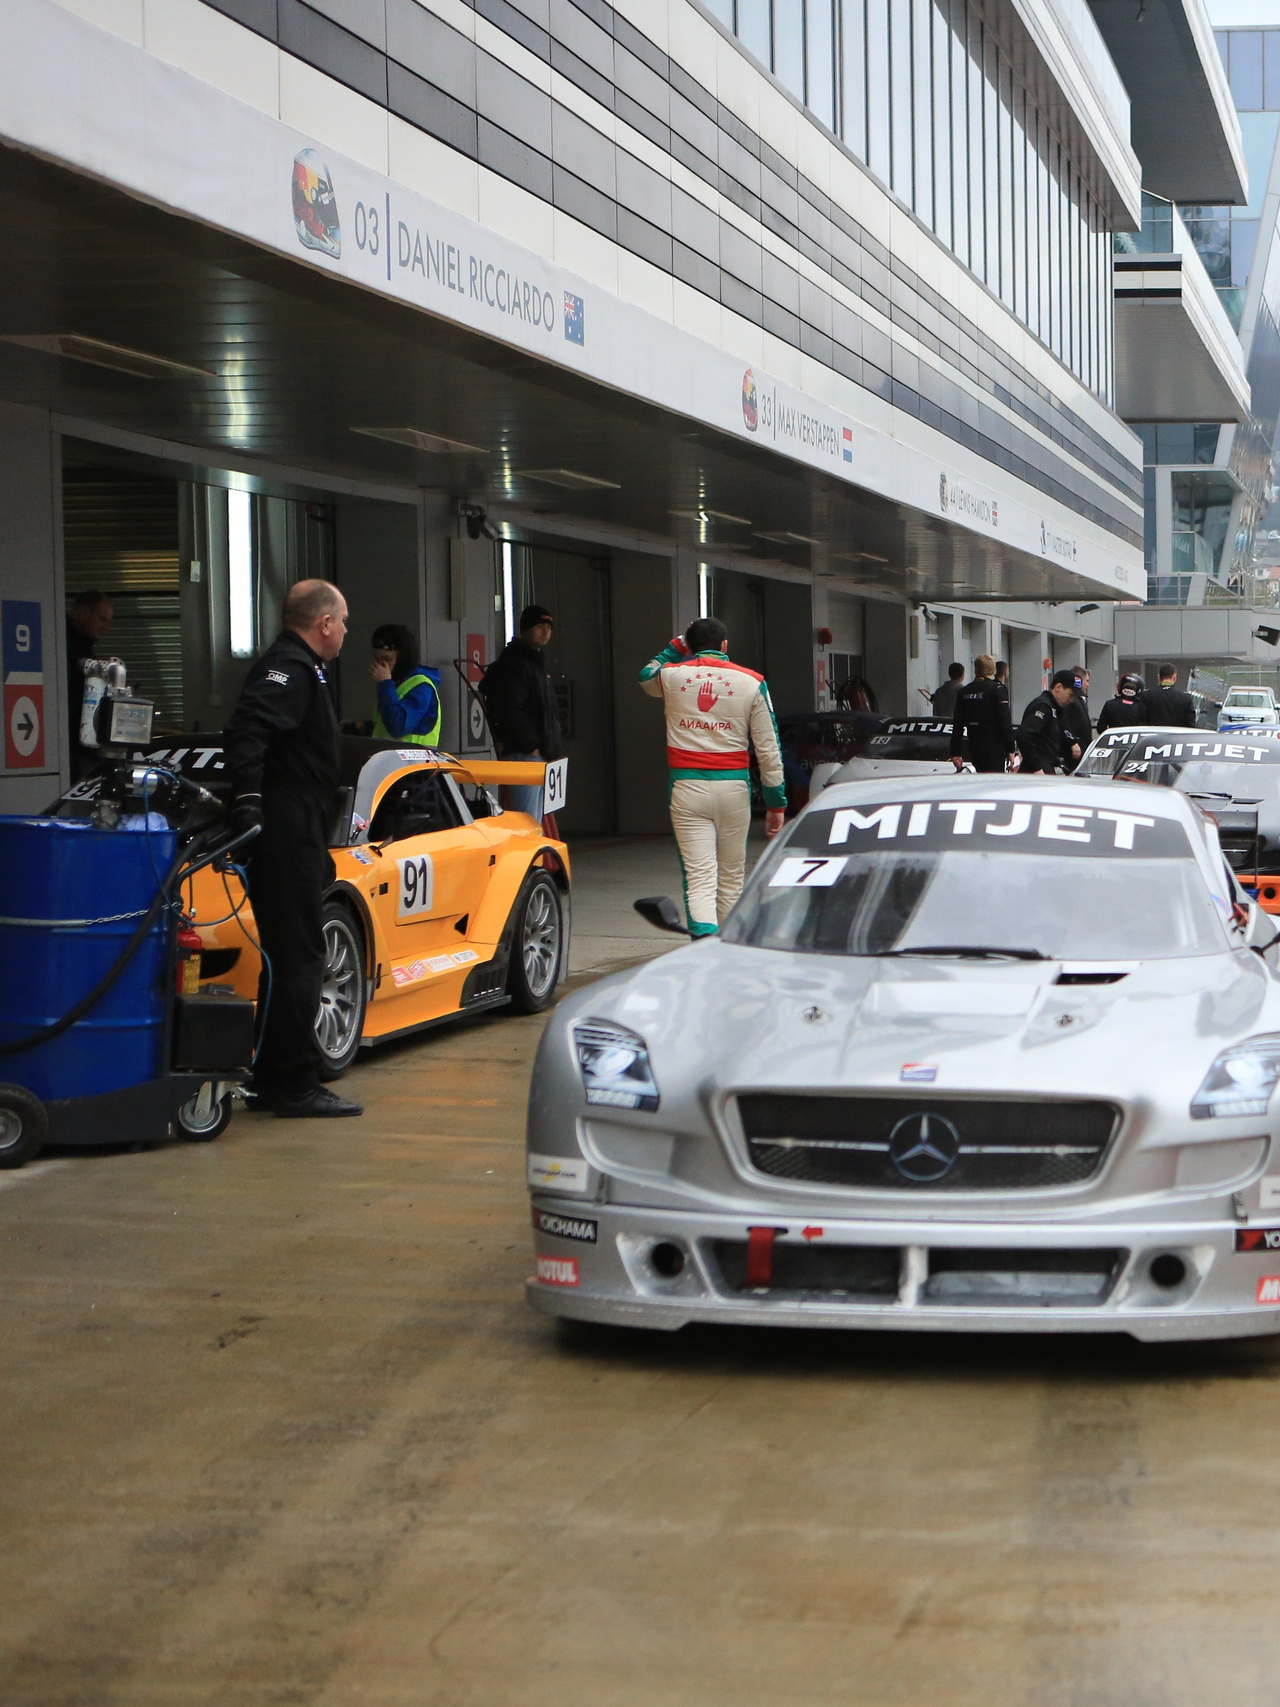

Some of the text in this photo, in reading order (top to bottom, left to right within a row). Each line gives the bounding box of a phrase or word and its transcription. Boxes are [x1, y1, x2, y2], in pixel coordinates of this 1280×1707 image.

[354, 201, 379, 256] 03
[397, 220, 464, 295] DANIEL
[469, 255, 555, 333] RICCIARDO
[761, 394, 840, 456] 33 MAX VERSTAPPEN
[15, 624, 31, 652] 9
[267, 672, 288, 684] OMP
[1096, 749, 1106, 757] 6
[1144, 743, 1269, 761] MITJET
[1124, 761, 1150, 773] 24
[549, 766, 562, 802] 91
[828, 803, 1155, 850] MITJET
[403, 857, 428, 909] 91
[796, 860, 829, 884] 7
